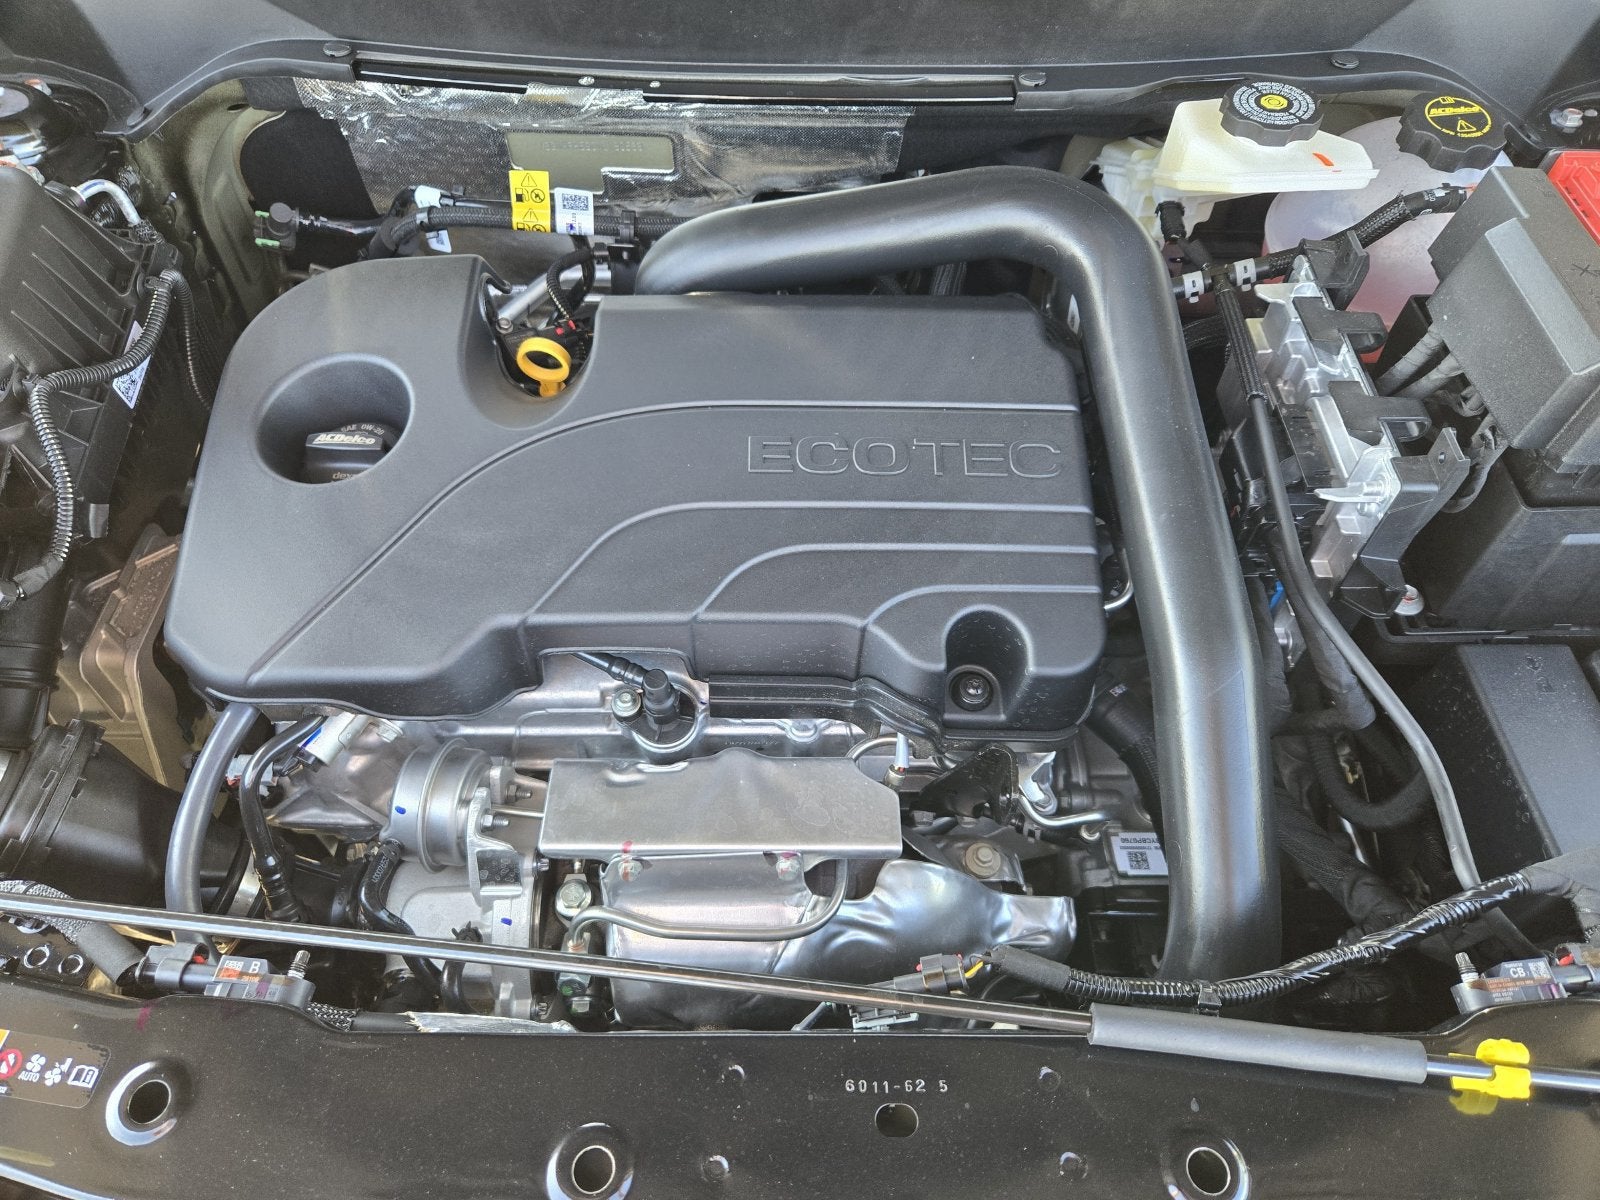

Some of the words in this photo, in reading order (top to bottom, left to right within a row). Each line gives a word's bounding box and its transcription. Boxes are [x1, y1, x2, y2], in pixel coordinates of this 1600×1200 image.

[1429, 106, 1481, 117] ACDelco
[341, 424, 358, 433] SAE
[361, 423, 385, 436] 0W-20
[312, 433, 376, 445] ACDelco
[748, 435, 1063, 478] ECOTEC
[249, 961, 261, 974] B
[1509, 967, 1526, 978] CB
[18, 1071, 40, 1083] AUTO
[845, 1079, 926, 1094] 6011-62
[939, 1079, 949, 1093] 5
